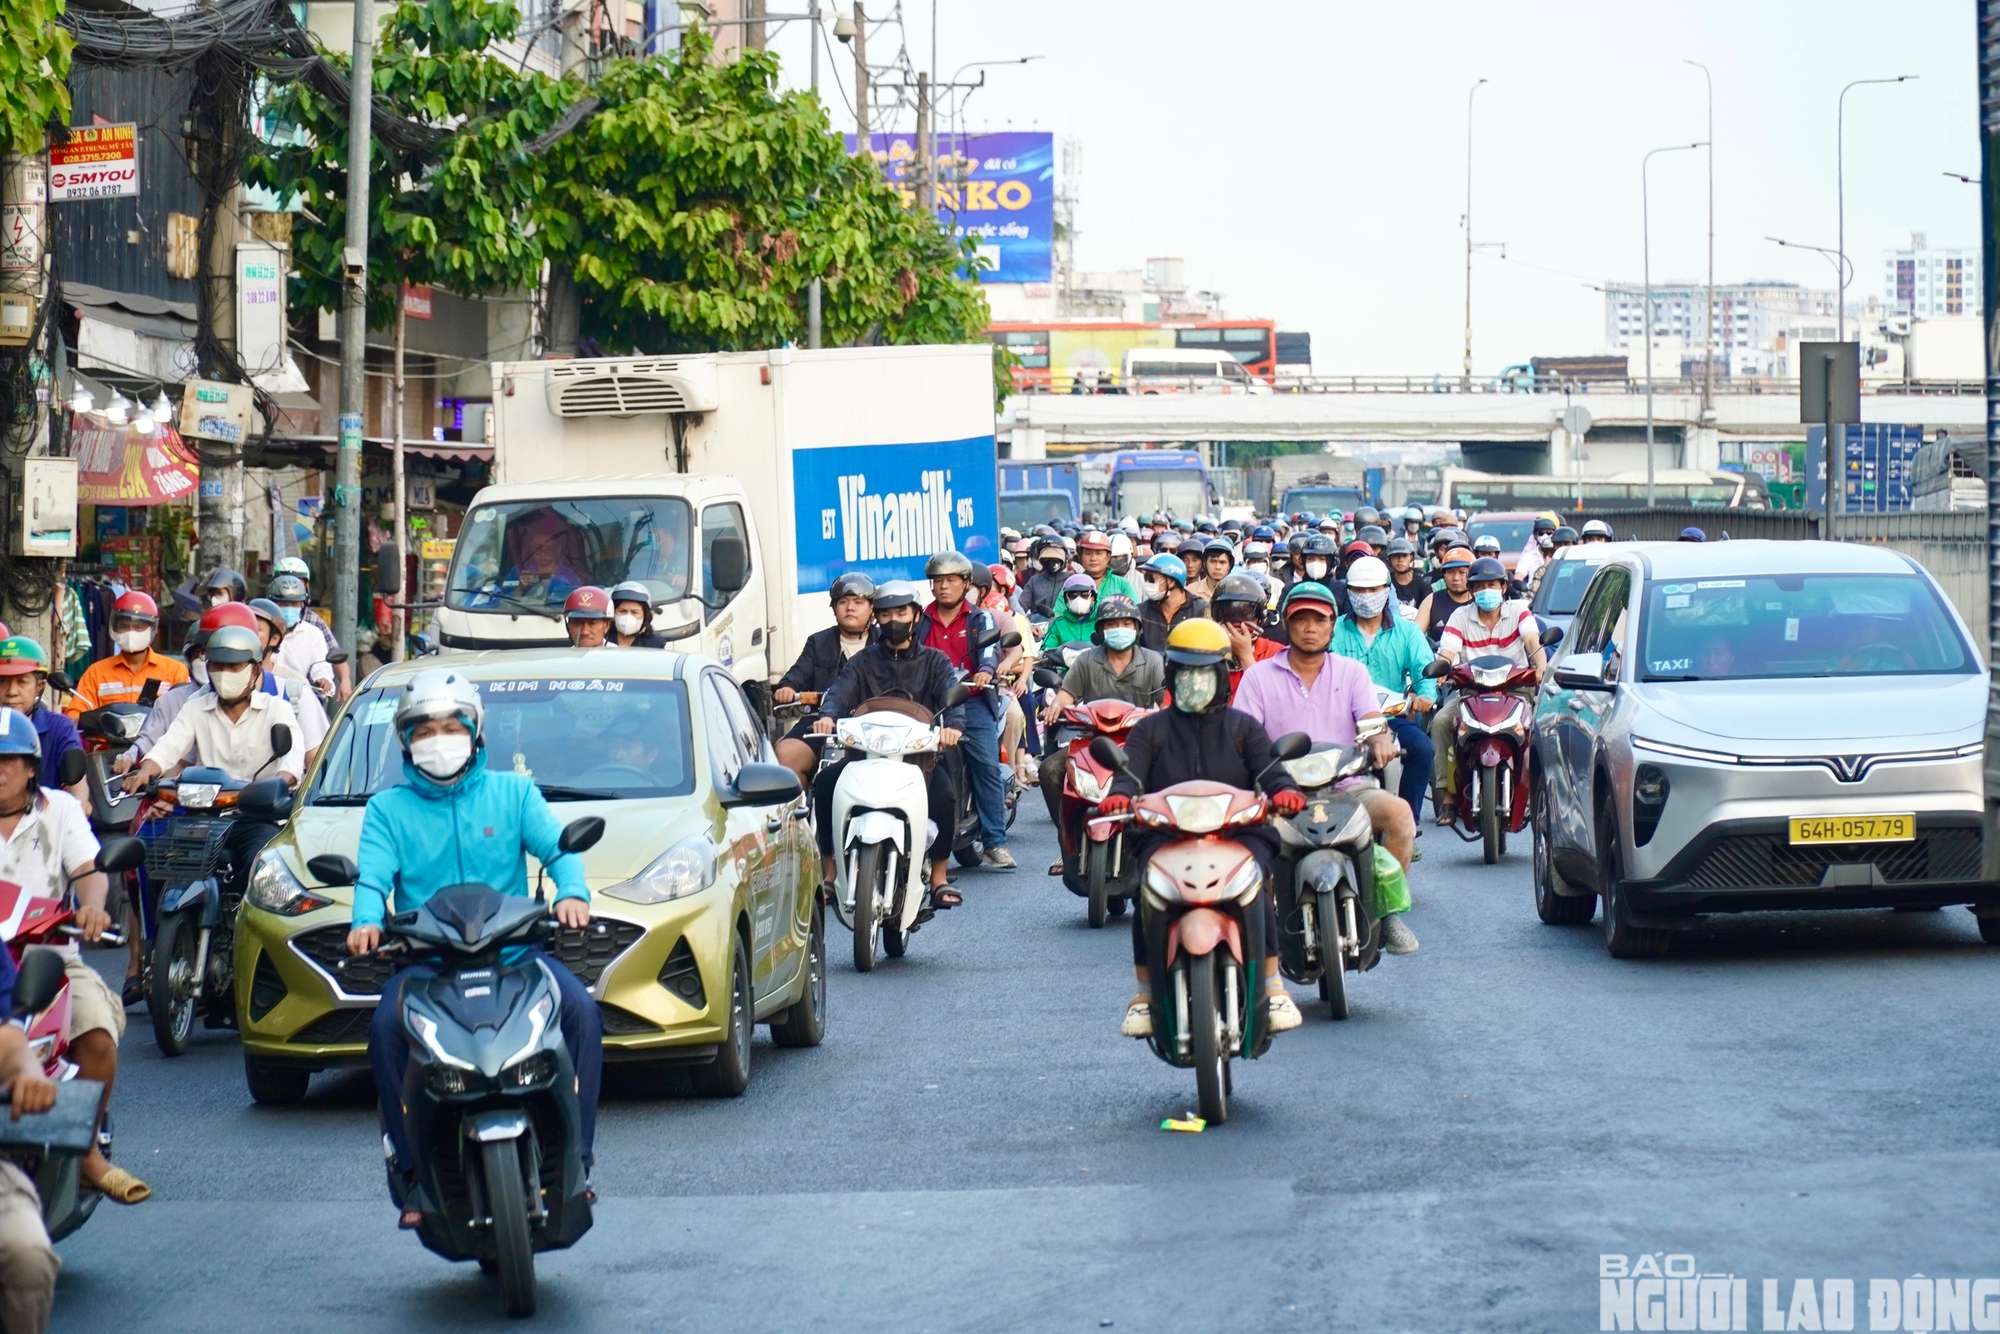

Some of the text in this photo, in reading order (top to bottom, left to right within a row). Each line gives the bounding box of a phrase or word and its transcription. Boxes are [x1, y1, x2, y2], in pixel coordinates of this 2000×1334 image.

[101, 125, 133, 141] AN NINH
[121, 141, 133, 149] TÂY
[67, 184, 122, 198] 0932 06 8787
[821, 469, 974, 562] EST Vinamilk 1976
[1653, 658, 1689, 672] TAXI
[489, 681, 539, 692] KIM
[549, 678, 624, 692] NGÂN
[1800, 819, 1904, 839] 64H-057.79
